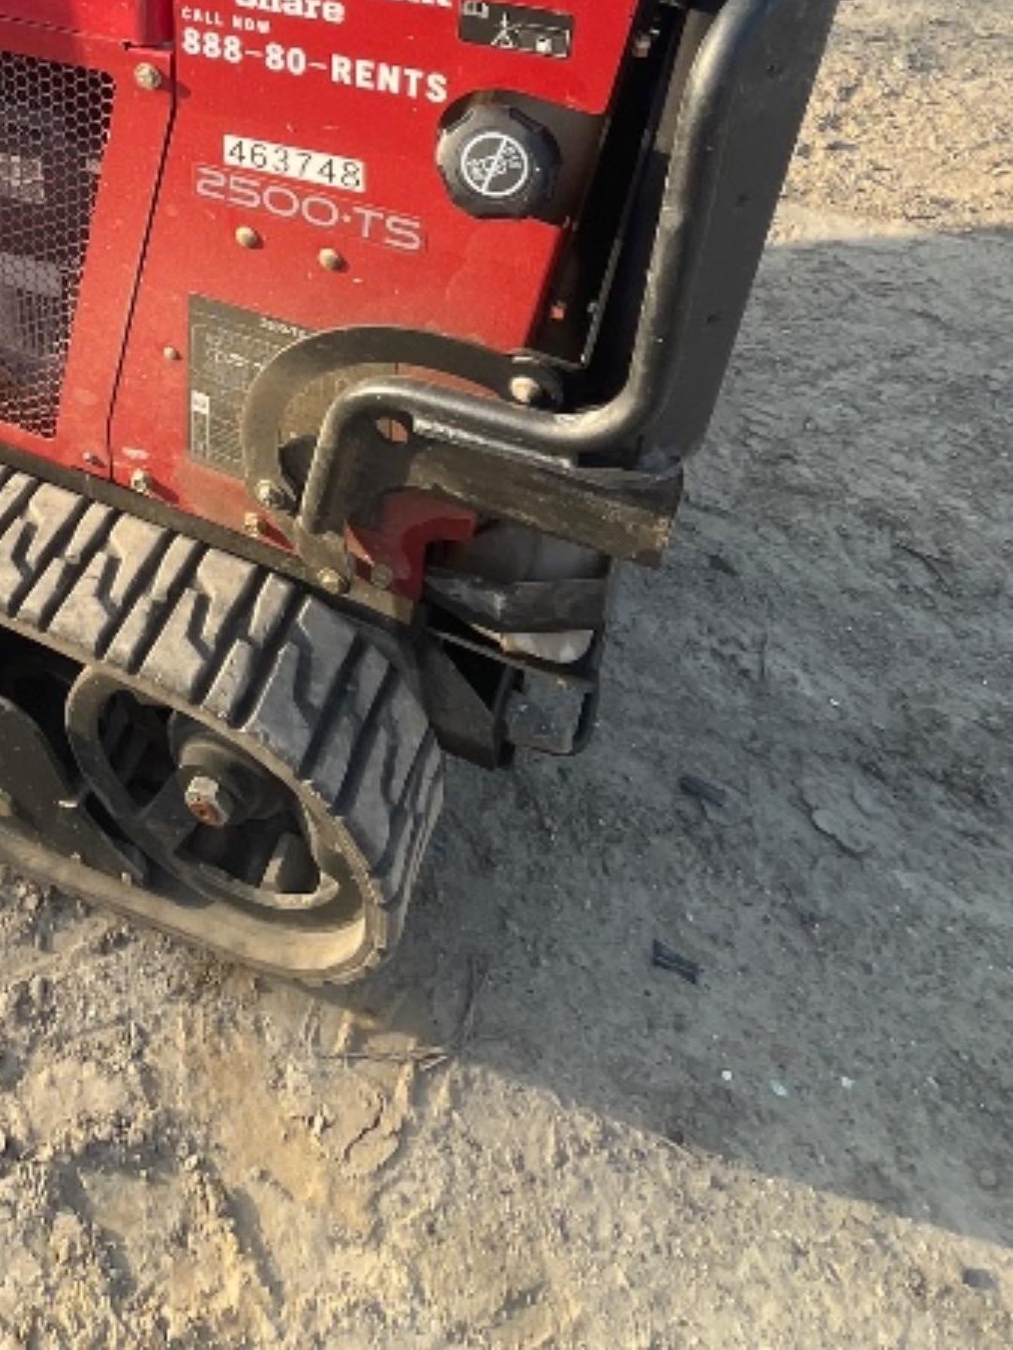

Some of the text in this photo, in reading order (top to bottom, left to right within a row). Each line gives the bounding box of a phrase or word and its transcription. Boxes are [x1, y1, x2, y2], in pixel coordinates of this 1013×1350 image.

[180, 6, 271, 34] CALL NOW
[182, 30, 447, 102] 888-80-RENTS
[227, 139, 362, 190] 463748
